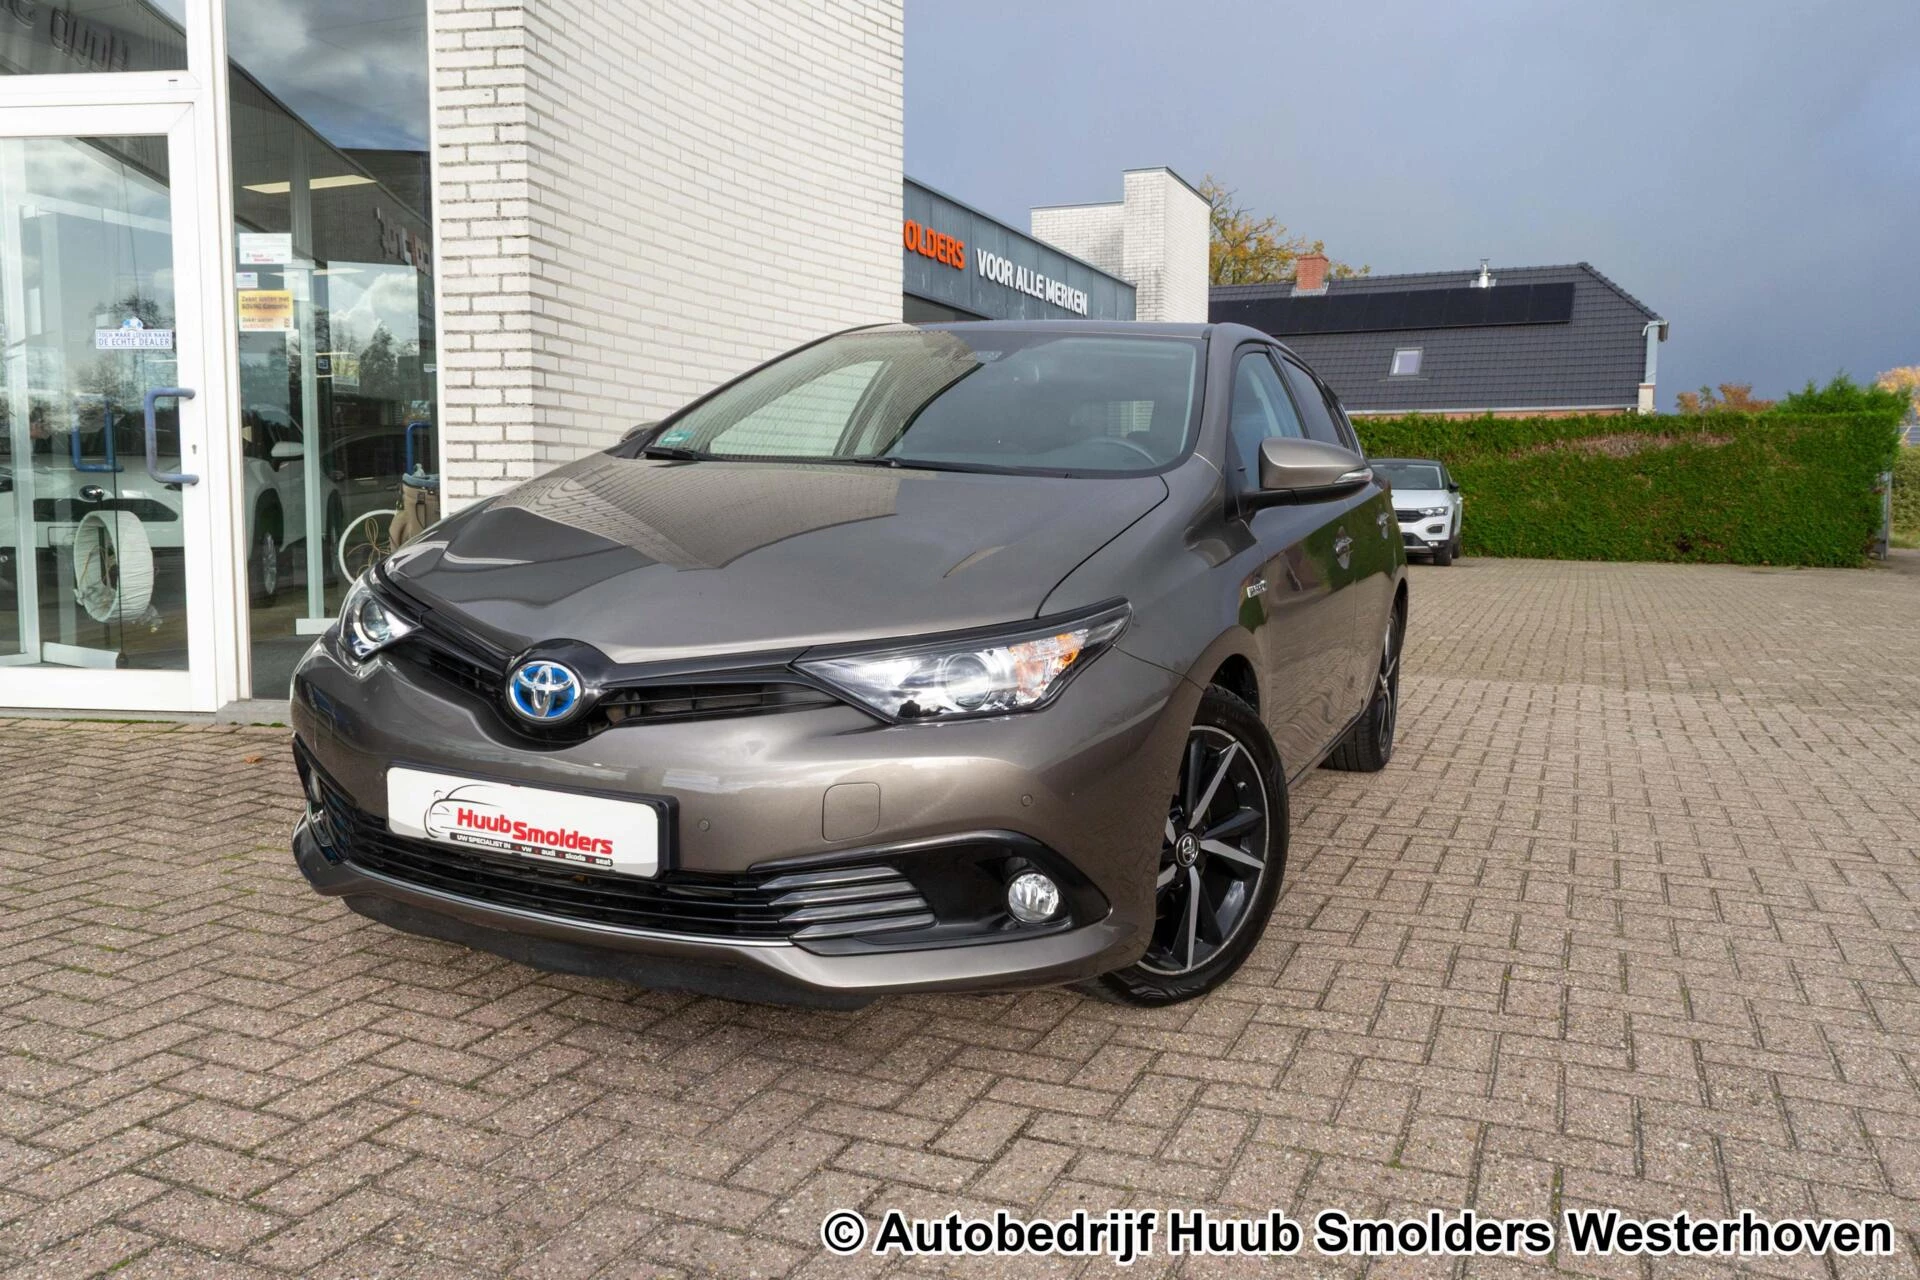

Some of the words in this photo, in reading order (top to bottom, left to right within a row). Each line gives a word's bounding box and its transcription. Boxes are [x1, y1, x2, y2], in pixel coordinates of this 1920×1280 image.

[904, 219, 965, 270] OLDERS
[977, 248, 1013, 287] VOOR
[1015, 265, 1044, 299] ALLE
[1046, 277, 1088, 316] MERKEN
[98, 338, 108, 346] DE
[111, 338, 136, 346] ECHTE
[139, 338, 170, 346] DEALER
[468, 836, 503, 849] SPECIALIST
[503, 841, 511, 849] IN
[541, 848, 556, 857] audi
[565, 852, 586, 862] skoda
[595, 857, 612, 866] seat
